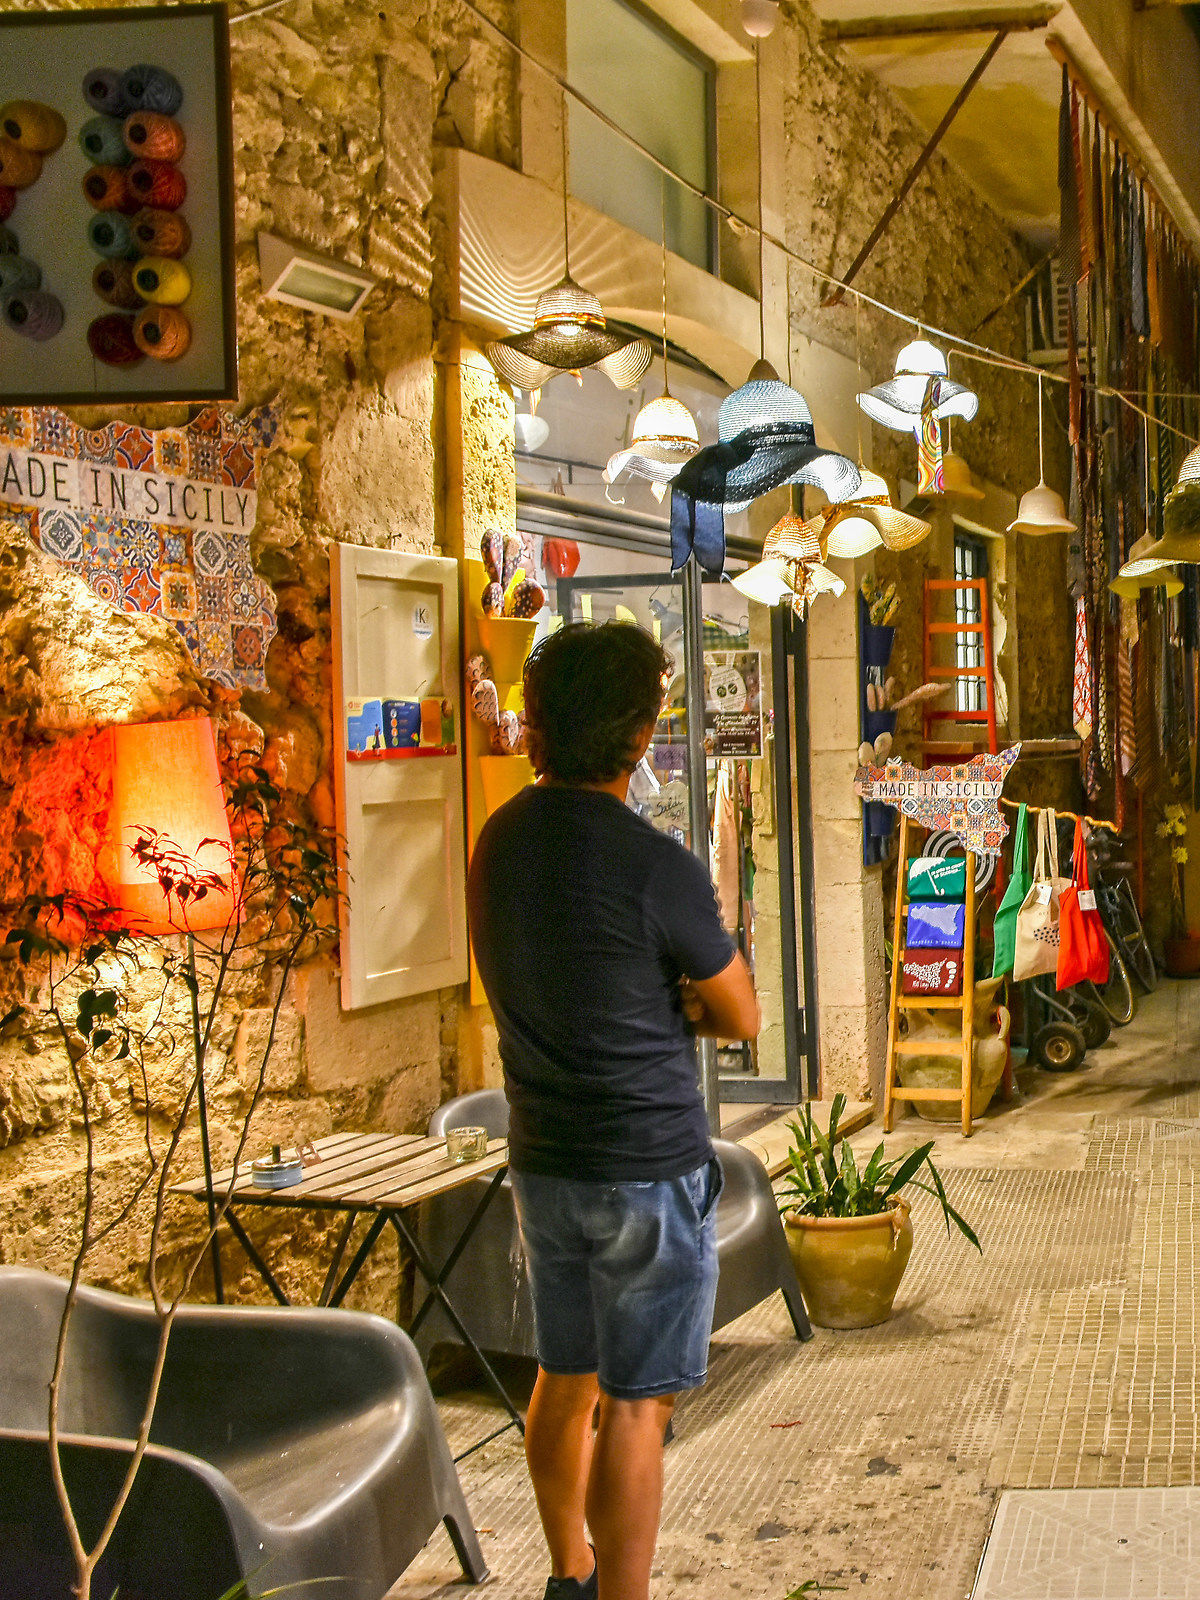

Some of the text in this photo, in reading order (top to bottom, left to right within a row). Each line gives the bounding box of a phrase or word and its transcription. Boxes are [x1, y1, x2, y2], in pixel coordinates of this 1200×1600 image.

[90, 467, 127, 511] IN
[144, 478, 248, 527] SICILY
[879, 782, 915, 796] MADE
[923, 782, 938, 796] IN
[945, 782, 998, 797] SICILY
